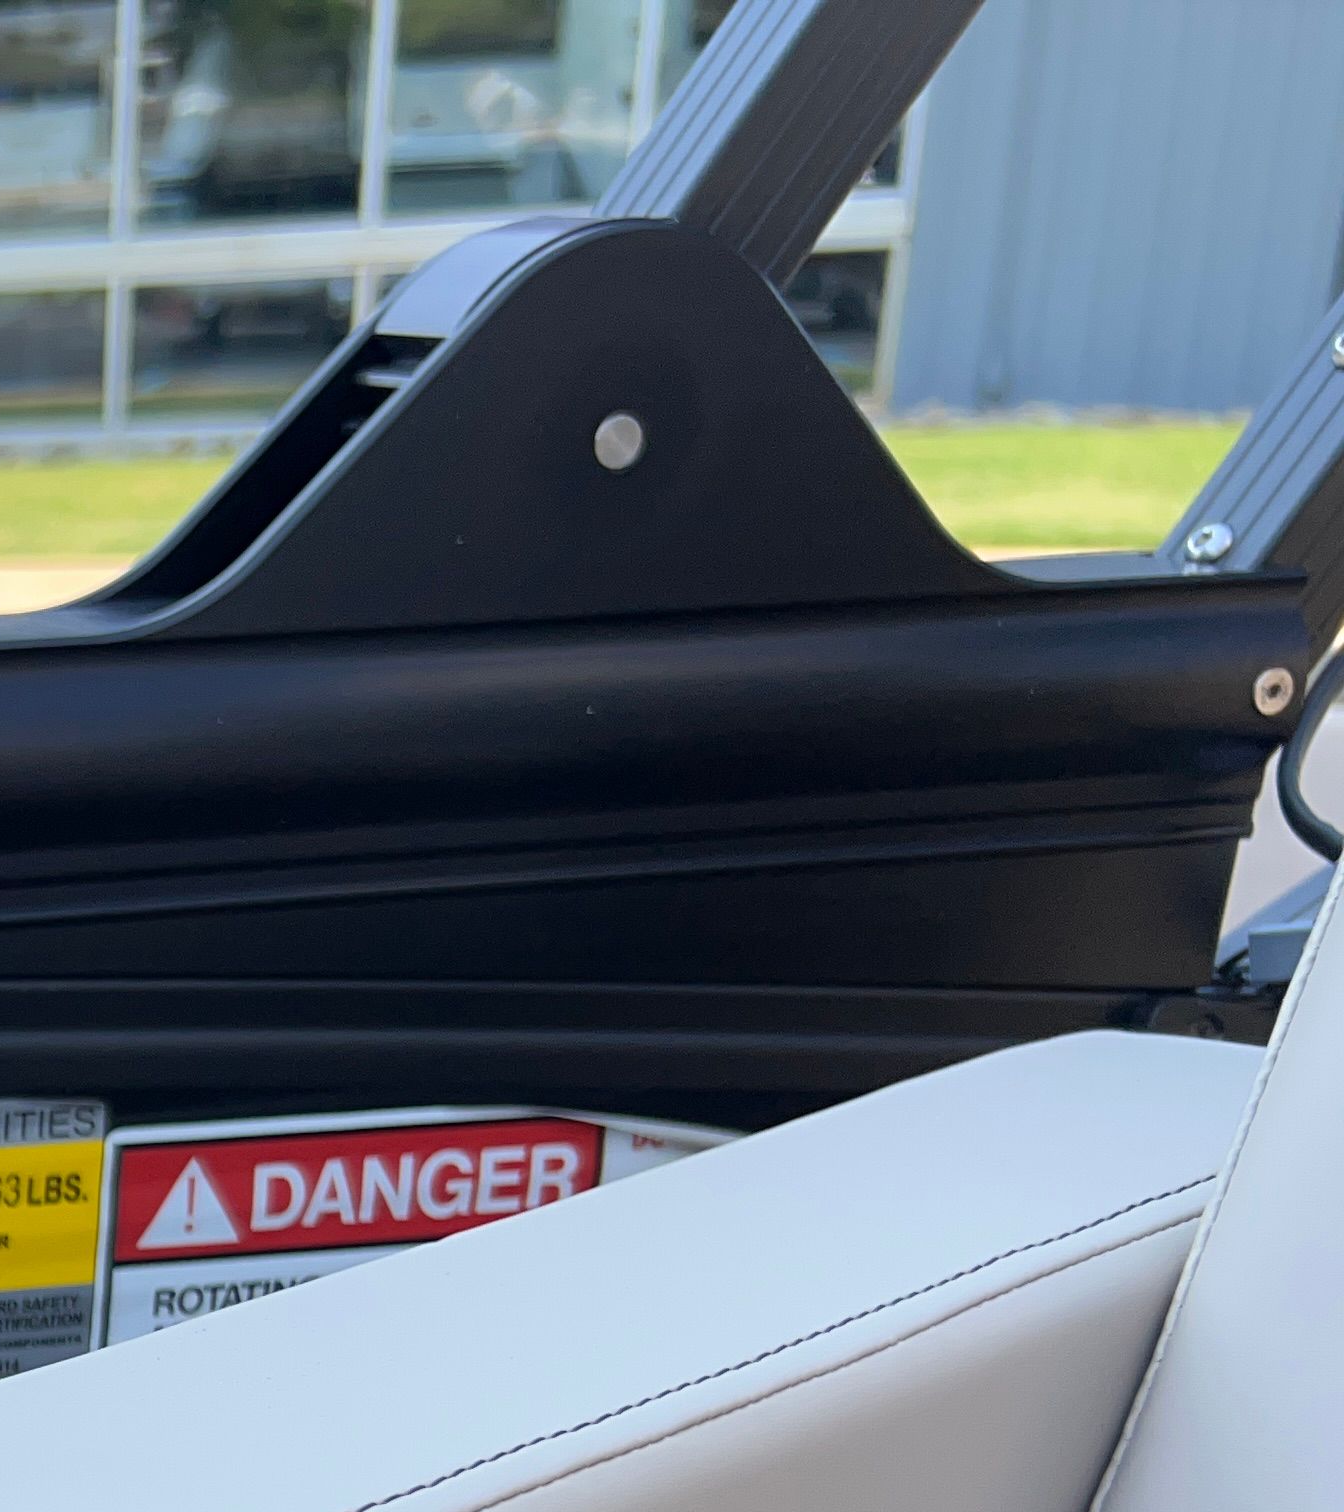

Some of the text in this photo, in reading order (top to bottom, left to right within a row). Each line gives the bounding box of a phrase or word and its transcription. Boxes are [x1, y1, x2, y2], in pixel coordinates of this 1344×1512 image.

[26, 1173, 89, 1207] LBS.
[251, 1142, 580, 1233] DANGER
[22, 1294, 80, 1312] SAFETY
[152, 1274, 320, 1317] ROTATI
